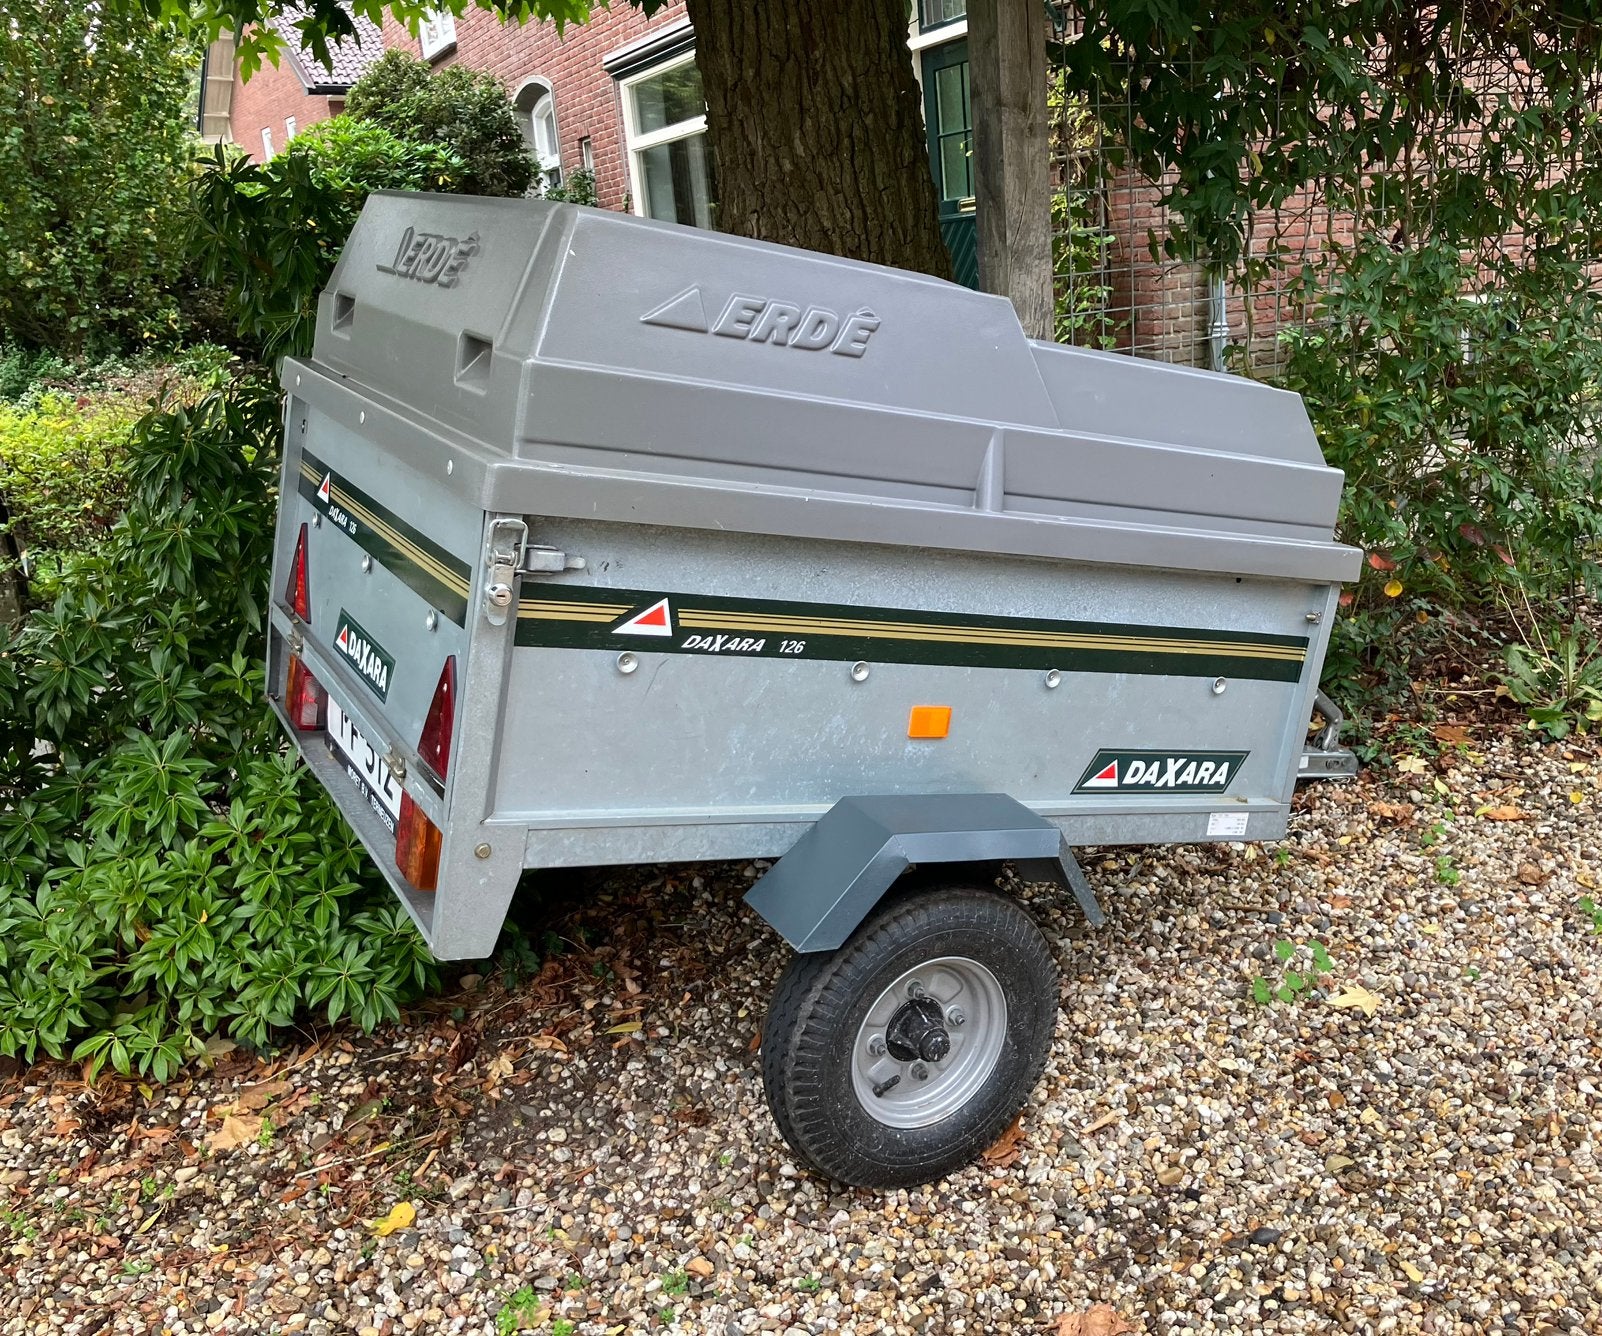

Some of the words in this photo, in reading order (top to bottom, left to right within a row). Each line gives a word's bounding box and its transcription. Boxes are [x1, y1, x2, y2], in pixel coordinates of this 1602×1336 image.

[328, 505, 348, 528] DAXARA
[348, 520, 358, 535] 126
[681, 634, 766, 652] DAXARA
[779, 640, 806, 654] 126
[348, 630, 388, 692] DAXARA
[1122, 758, 1230, 787] DAXARA
